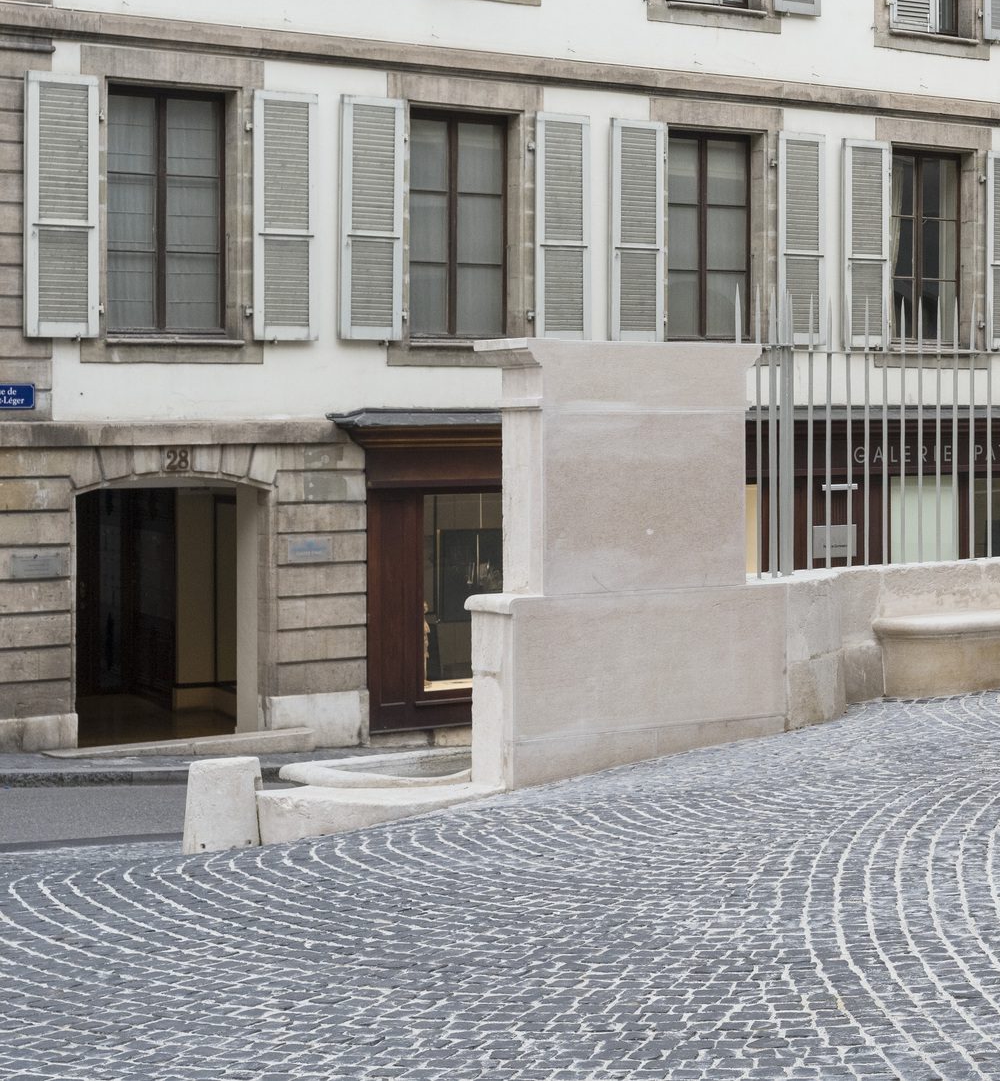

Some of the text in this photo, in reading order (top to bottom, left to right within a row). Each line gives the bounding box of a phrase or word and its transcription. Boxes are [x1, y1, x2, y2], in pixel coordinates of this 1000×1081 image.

[7, 387, 17, 395] de
[166, 449, 189, 470] 28
[853, 445, 952, 464] GALERIE
